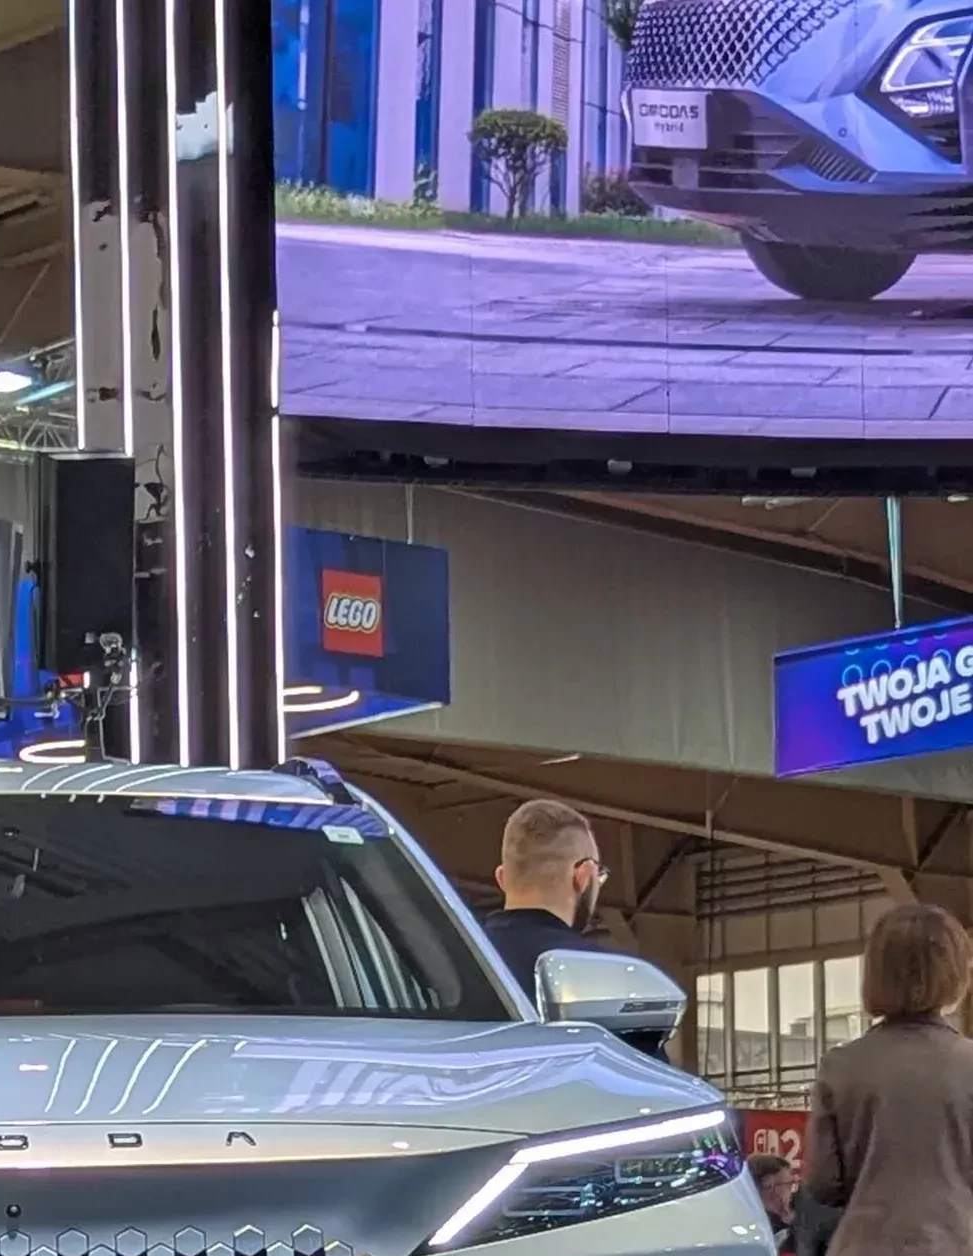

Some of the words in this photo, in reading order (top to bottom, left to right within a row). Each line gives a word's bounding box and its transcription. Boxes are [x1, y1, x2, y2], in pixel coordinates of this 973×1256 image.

[326, 595, 378, 631] LEGO
[836, 657, 951, 717] TWOJA
[860, 683, 972, 744] TWOJE
